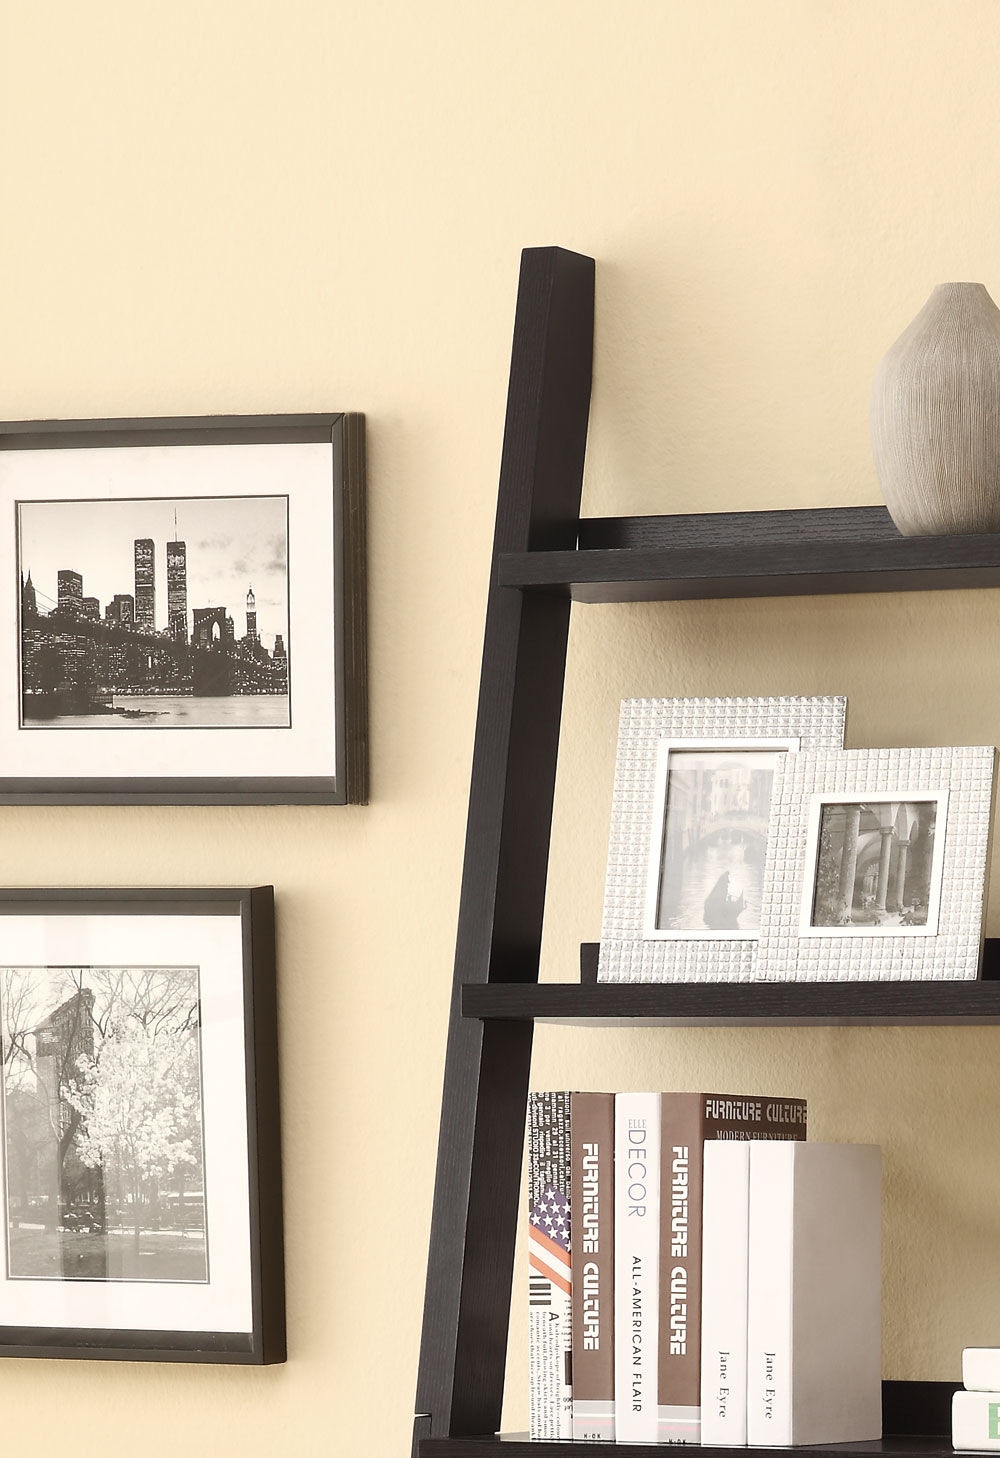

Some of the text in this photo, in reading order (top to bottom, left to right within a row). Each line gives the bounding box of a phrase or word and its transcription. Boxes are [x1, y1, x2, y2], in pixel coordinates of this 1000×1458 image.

[628, 1118, 647, 1129] ELLE
[705, 1099, 807, 1124] FURNITURE CULTURE
[628, 1129, 647, 1218] DECOR
[583, 1143, 600, 1350] FURNITURE CULTURE
[670, 1146, 689, 1356] FURNITURE CULTURE
[631, 1256, 643, 1413] ALL-AMERICAN FLAIR
[717, 1351, 730, 1418] Jane Eyre
[763, 1352, 776, 1419] Jane Eyre
